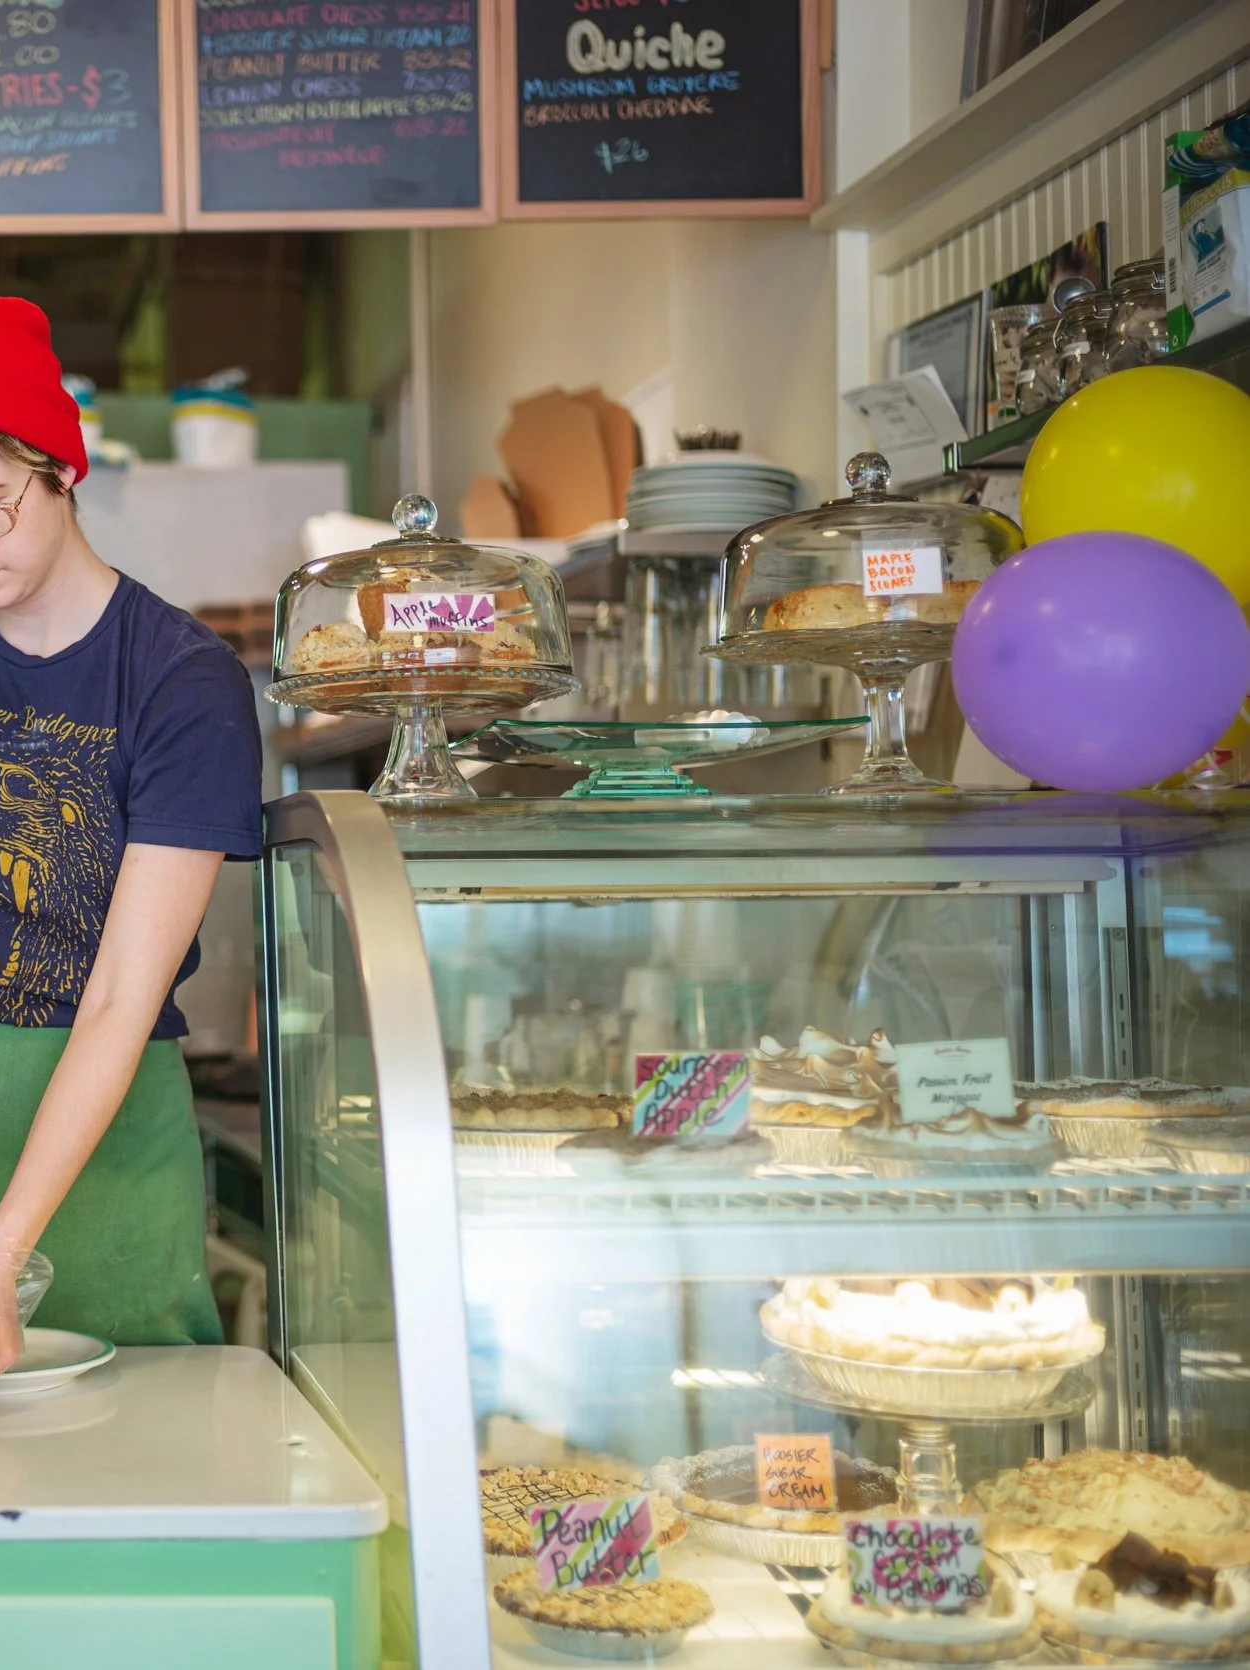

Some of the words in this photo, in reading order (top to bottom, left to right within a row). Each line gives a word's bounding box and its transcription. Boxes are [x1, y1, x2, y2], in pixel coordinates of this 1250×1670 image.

[566, 19, 726, 73] Quiche
[523, 76, 636, 101] MUSHROOM
[646, 70, 742, 95] GRUYERE
[617, 95, 715, 120] CHEDDAR
[867, 552, 912, 566] MAPLE
[867, 564, 916, 579] BACON
[429, 612, 488, 628] muffins
[21, 705, 117, 746] Bridgeport
[916, 1076, 958, 1089] Passion
[963, 1073, 993, 1086] Fruit
[643, 1102, 725, 1133] Apple
[763, 1447, 820, 1463] HOOSIER
[766, 1466, 813, 1480] SUGAR
[768, 1482, 826, 1500] CREAM
[540, 1503, 644, 1547] Peanut
[852, 1522, 981, 1549] Chocolate
[551, 1547, 658, 1588] Butter
[873, 1550, 960, 1570] Cream
